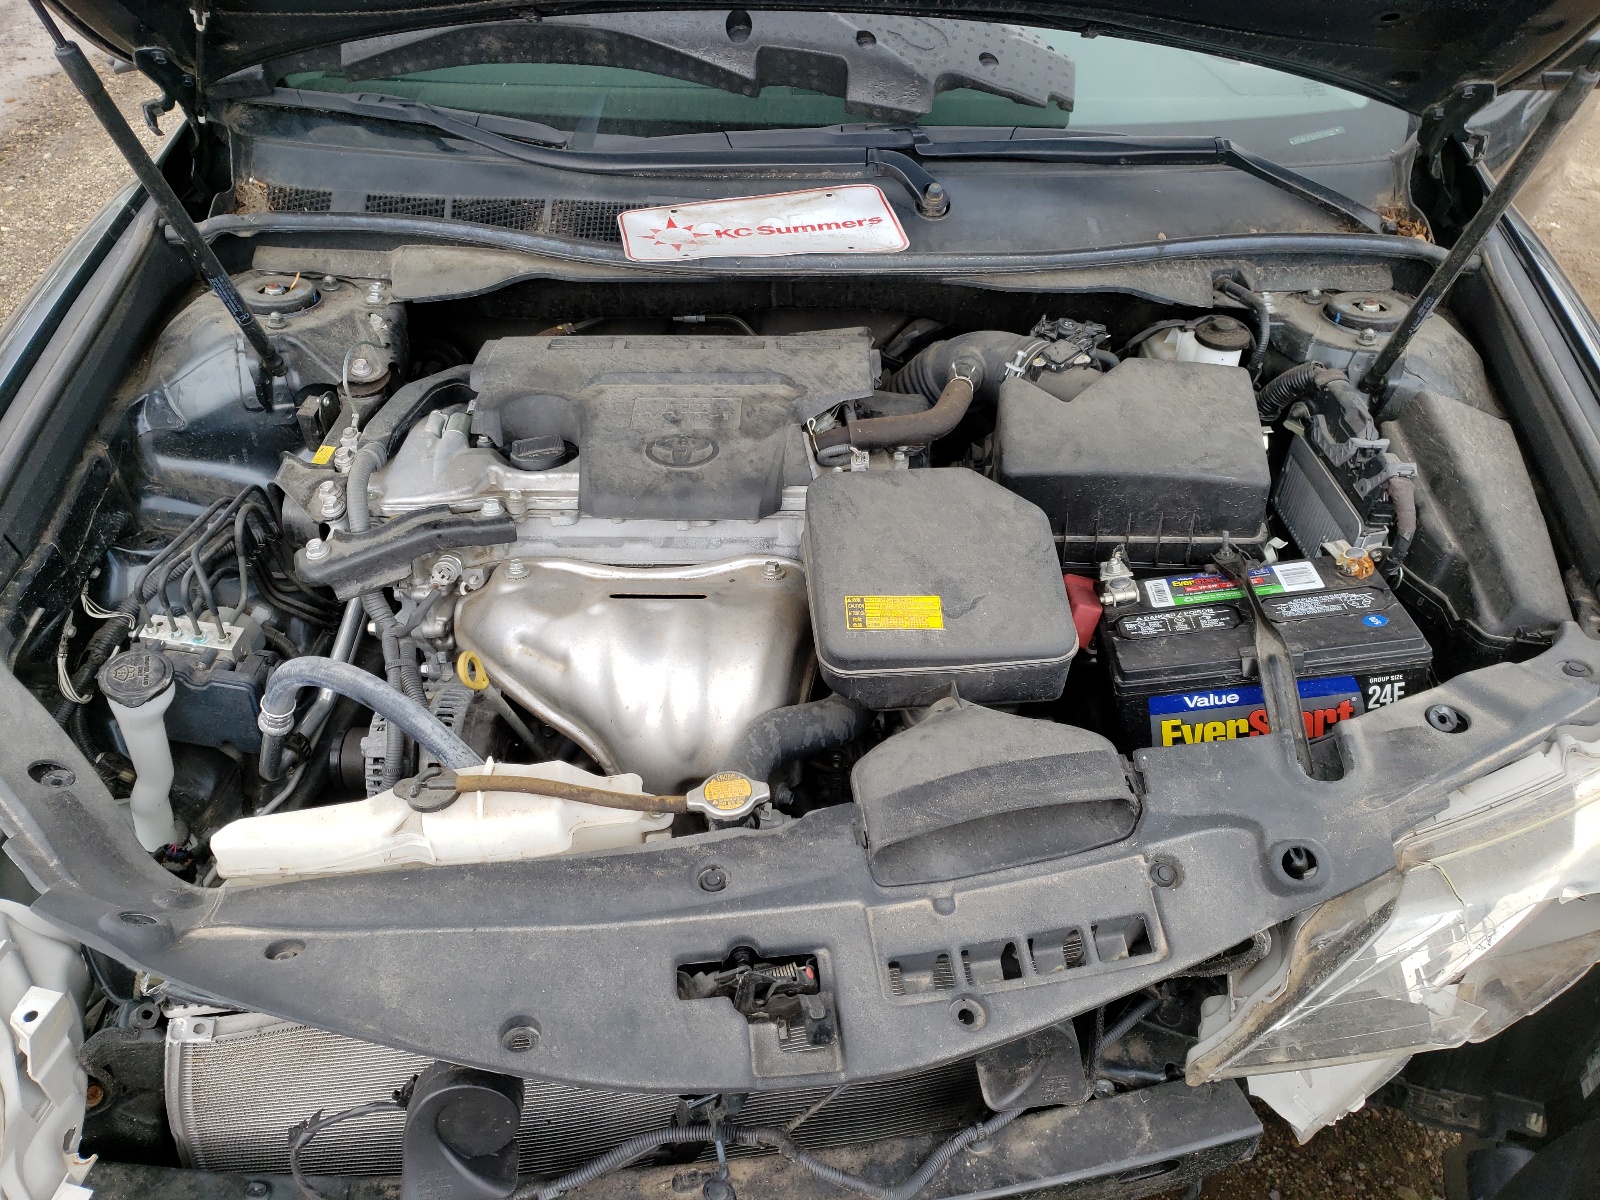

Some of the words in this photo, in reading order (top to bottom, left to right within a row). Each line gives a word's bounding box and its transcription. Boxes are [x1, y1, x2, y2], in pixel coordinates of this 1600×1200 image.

[714, 227, 753, 239] KC
[756, 216, 883, 236] Summers
[1369, 676, 1390, 684] GROUP
[1184, 693, 1240, 708] Value
[1368, 681, 1406, 709] 24F
[1161, 700, 1355, 747] EverSrt
